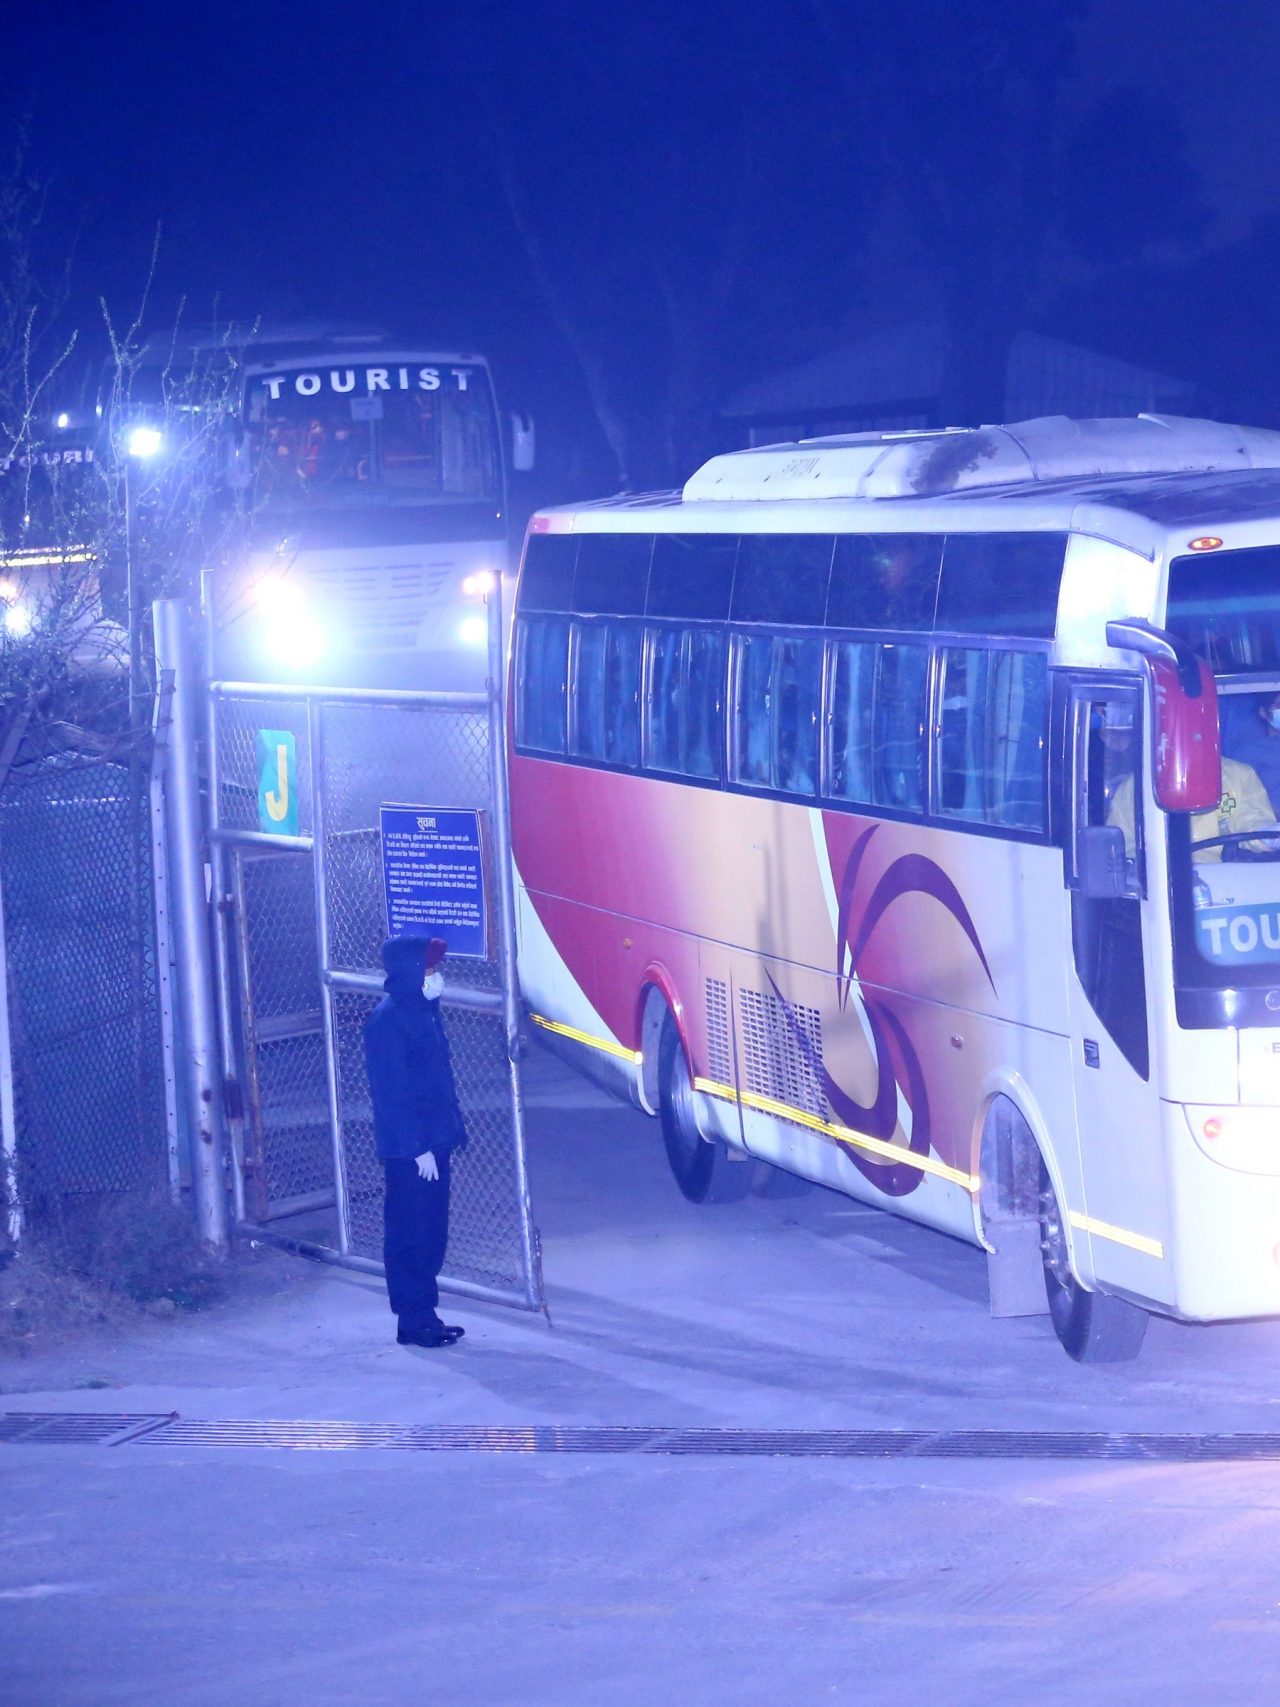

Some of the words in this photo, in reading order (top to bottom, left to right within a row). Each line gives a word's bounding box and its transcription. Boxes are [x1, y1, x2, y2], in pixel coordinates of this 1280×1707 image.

[262, 368, 472, 400] TOURIST
[265, 744, 288, 822] J
[416, 816, 437, 830] सूचना
